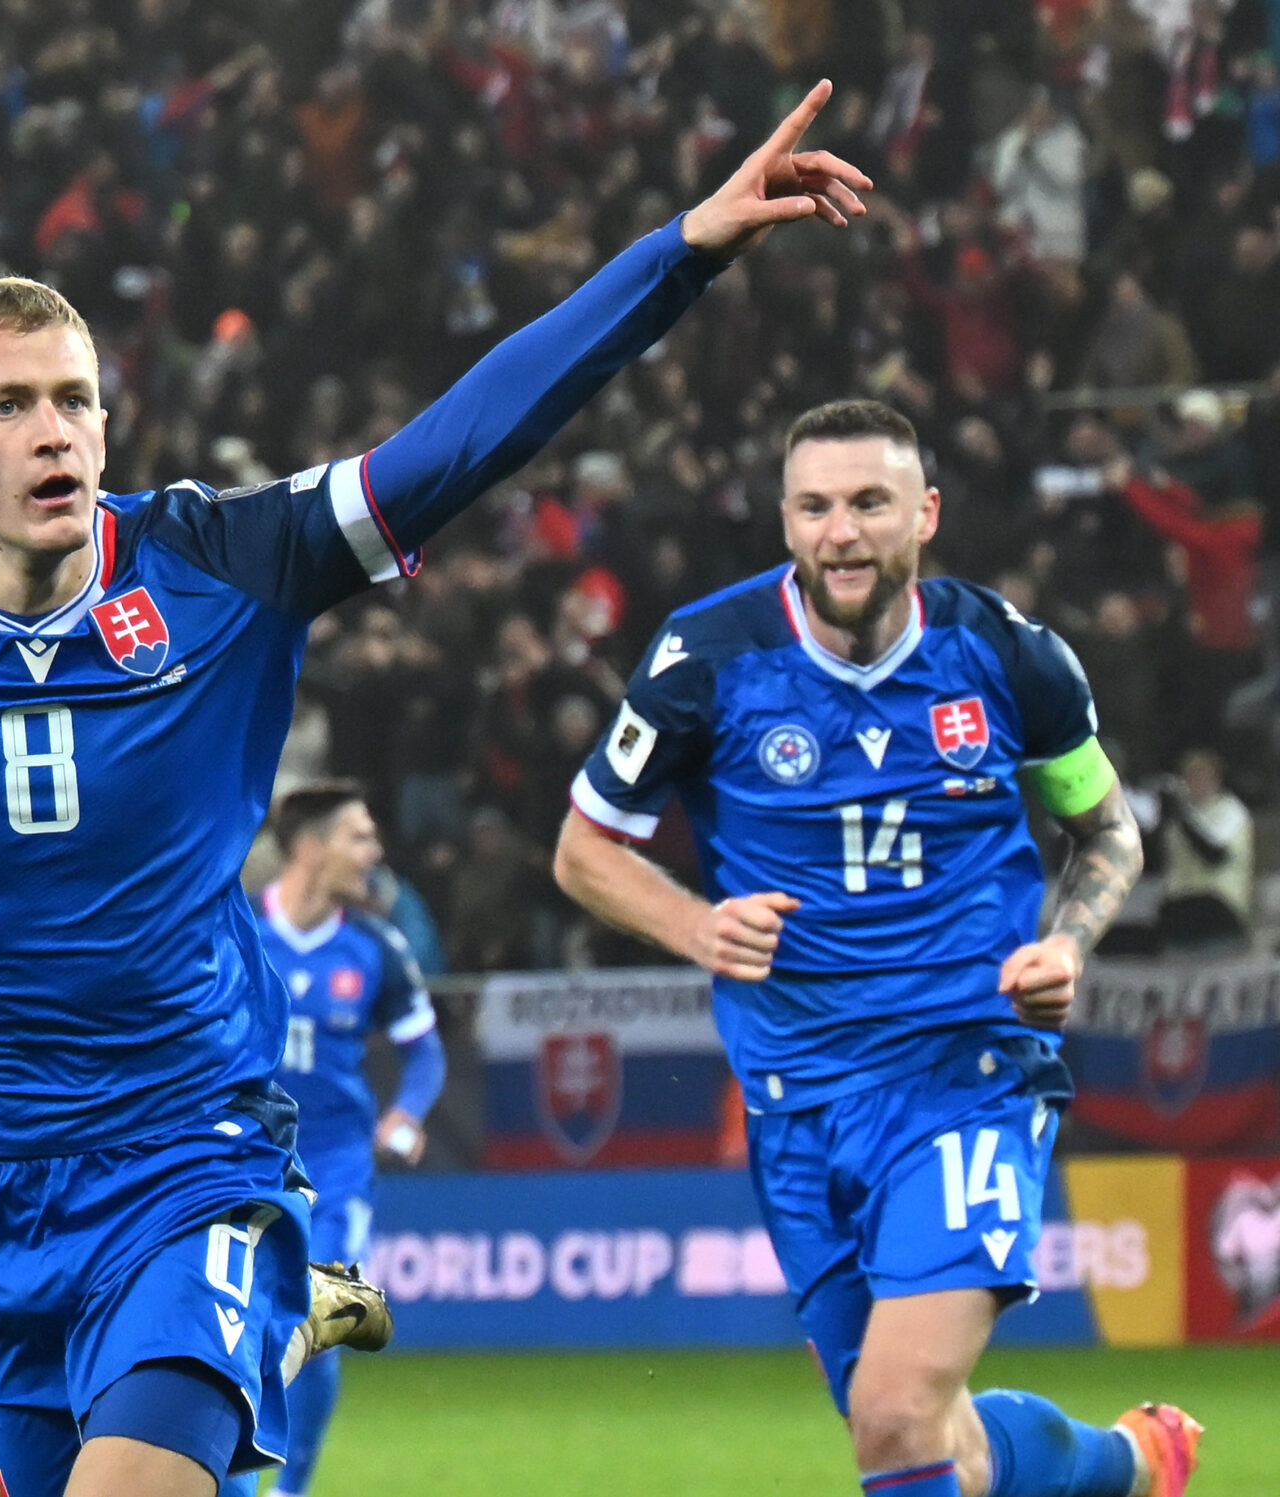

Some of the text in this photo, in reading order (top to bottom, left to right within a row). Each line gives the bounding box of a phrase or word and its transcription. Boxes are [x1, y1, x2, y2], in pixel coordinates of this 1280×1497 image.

[1, 703, 80, 834] 8
[832, 799, 924, 892] 14
[932, 1128, 1021, 1231] 14
[552, 1227, 675, 1301] CUP
